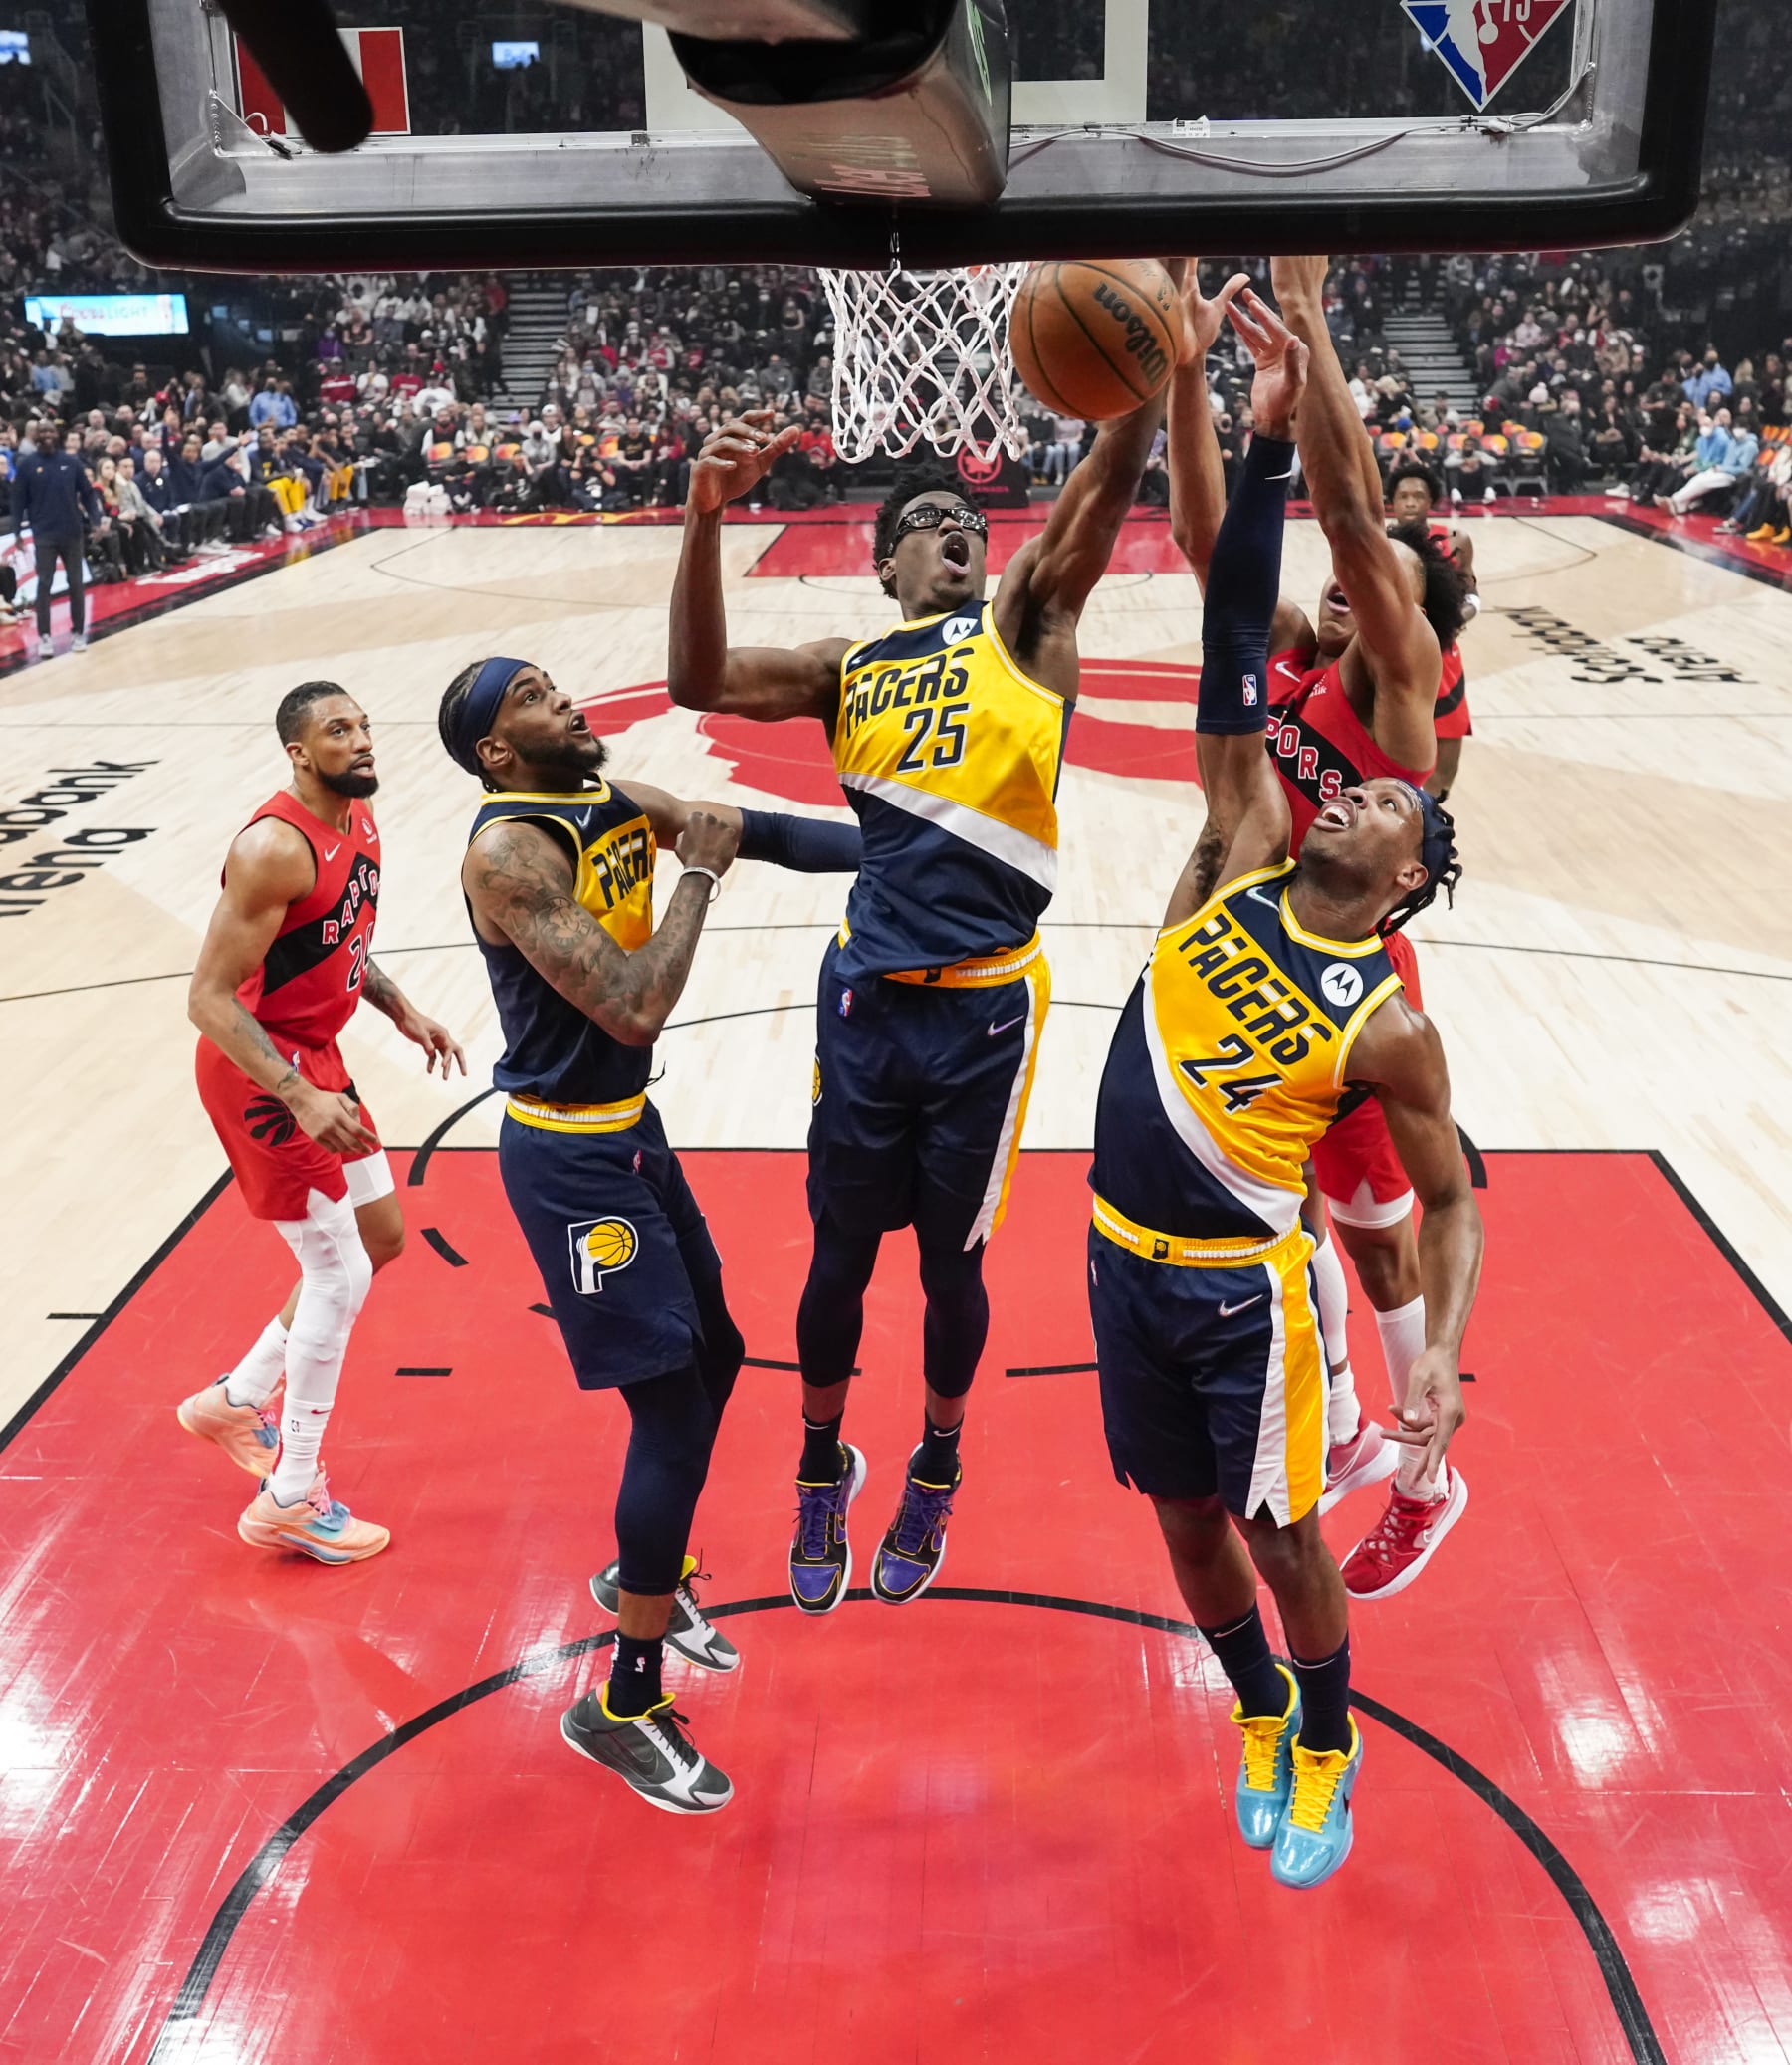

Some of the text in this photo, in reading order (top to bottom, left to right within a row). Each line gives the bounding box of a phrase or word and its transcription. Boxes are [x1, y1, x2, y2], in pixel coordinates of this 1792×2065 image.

[1093, 281, 1169, 387] Wilson
[1477, 605, 1664, 685] Scotiabank
[1623, 634, 1760, 684] Arena
[845, 647, 975, 740] PACERS
[896, 703, 973, 774] 25
[322, 863, 381, 946] RAPTO
[1179, 913, 1332, 1065] PACERS
[1179, 1033, 1284, 1115] 24
